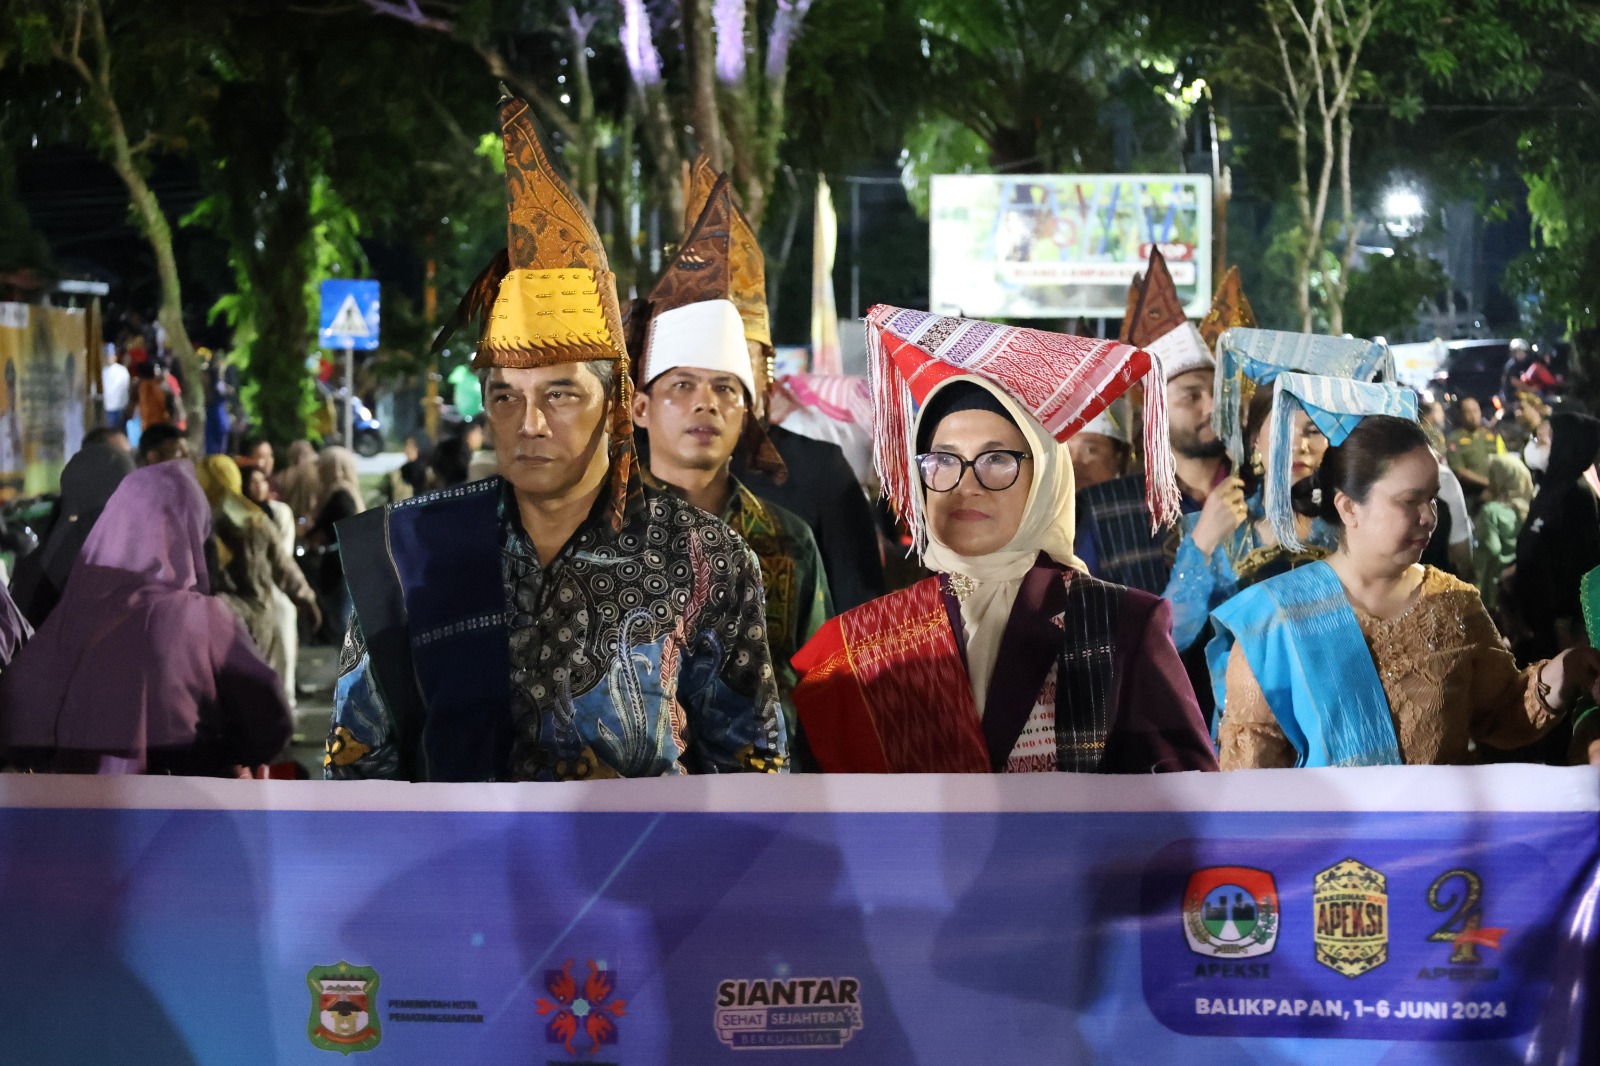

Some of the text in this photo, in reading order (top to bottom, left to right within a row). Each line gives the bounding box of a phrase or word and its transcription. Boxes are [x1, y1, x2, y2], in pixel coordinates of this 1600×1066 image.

[1317, 901, 1383, 937] APEKSI
[1194, 963, 1270, 979] APEKSI
[718, 979, 858, 1007] SIANTAR
[453, 1001, 478, 1009] KOTA
[1195, 998, 1507, 1020] BALIKPAPAN, 1-6 JUNI 2024
[723, 1012, 845, 1026] SEHAT SEJAHTERA
[742, 1033, 832, 1044] BERKUALITAS
